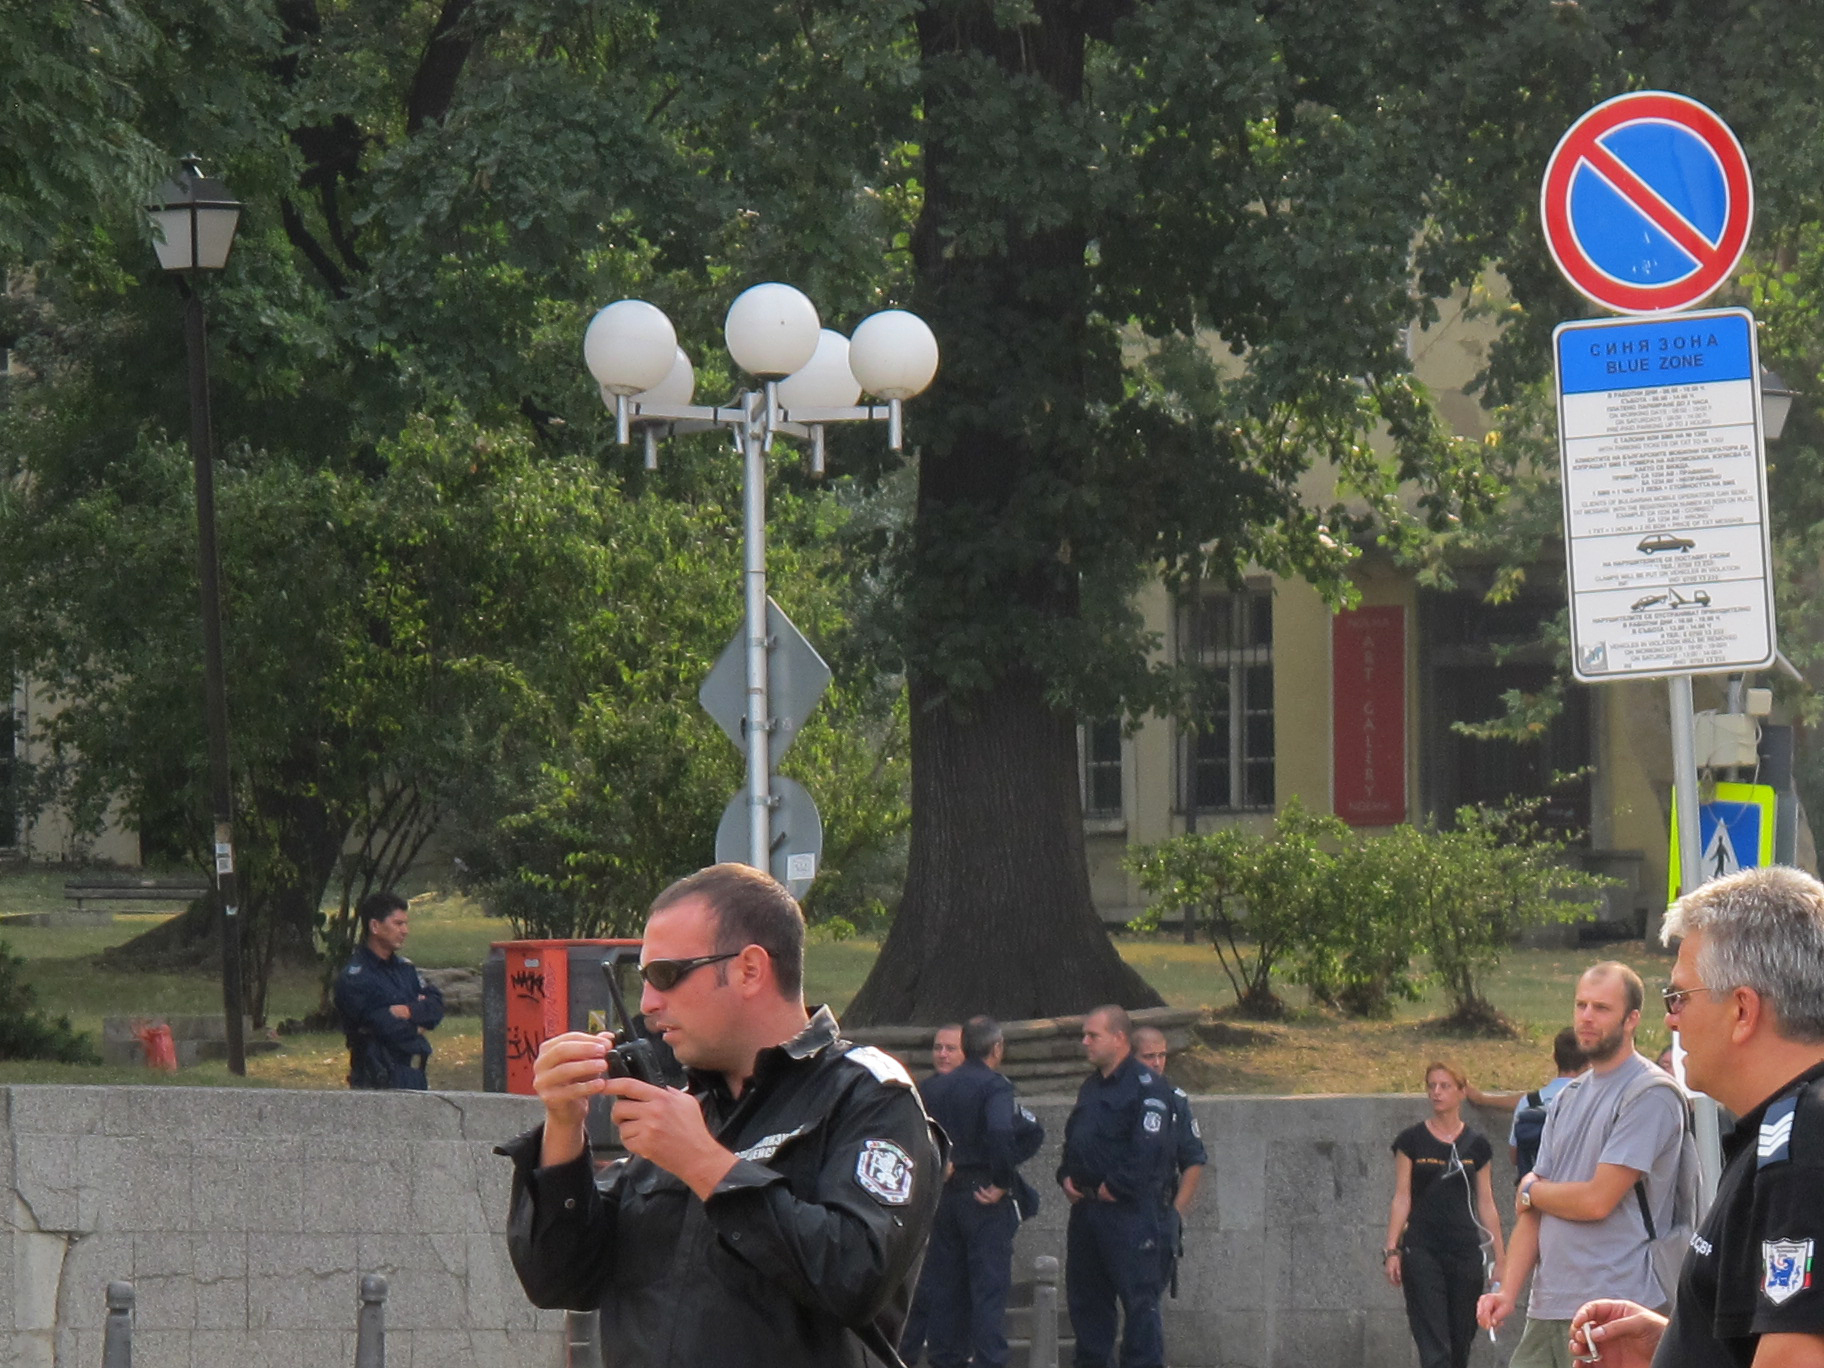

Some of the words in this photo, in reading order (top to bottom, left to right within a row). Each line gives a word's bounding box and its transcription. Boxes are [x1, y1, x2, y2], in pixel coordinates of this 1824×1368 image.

[1590, 340, 1649, 357] СИНЯ
[1659, 333, 1718, 351] ЗОНА
[1606, 357, 1649, 374] BLUE
[1659, 353, 1704, 370] ZONE
